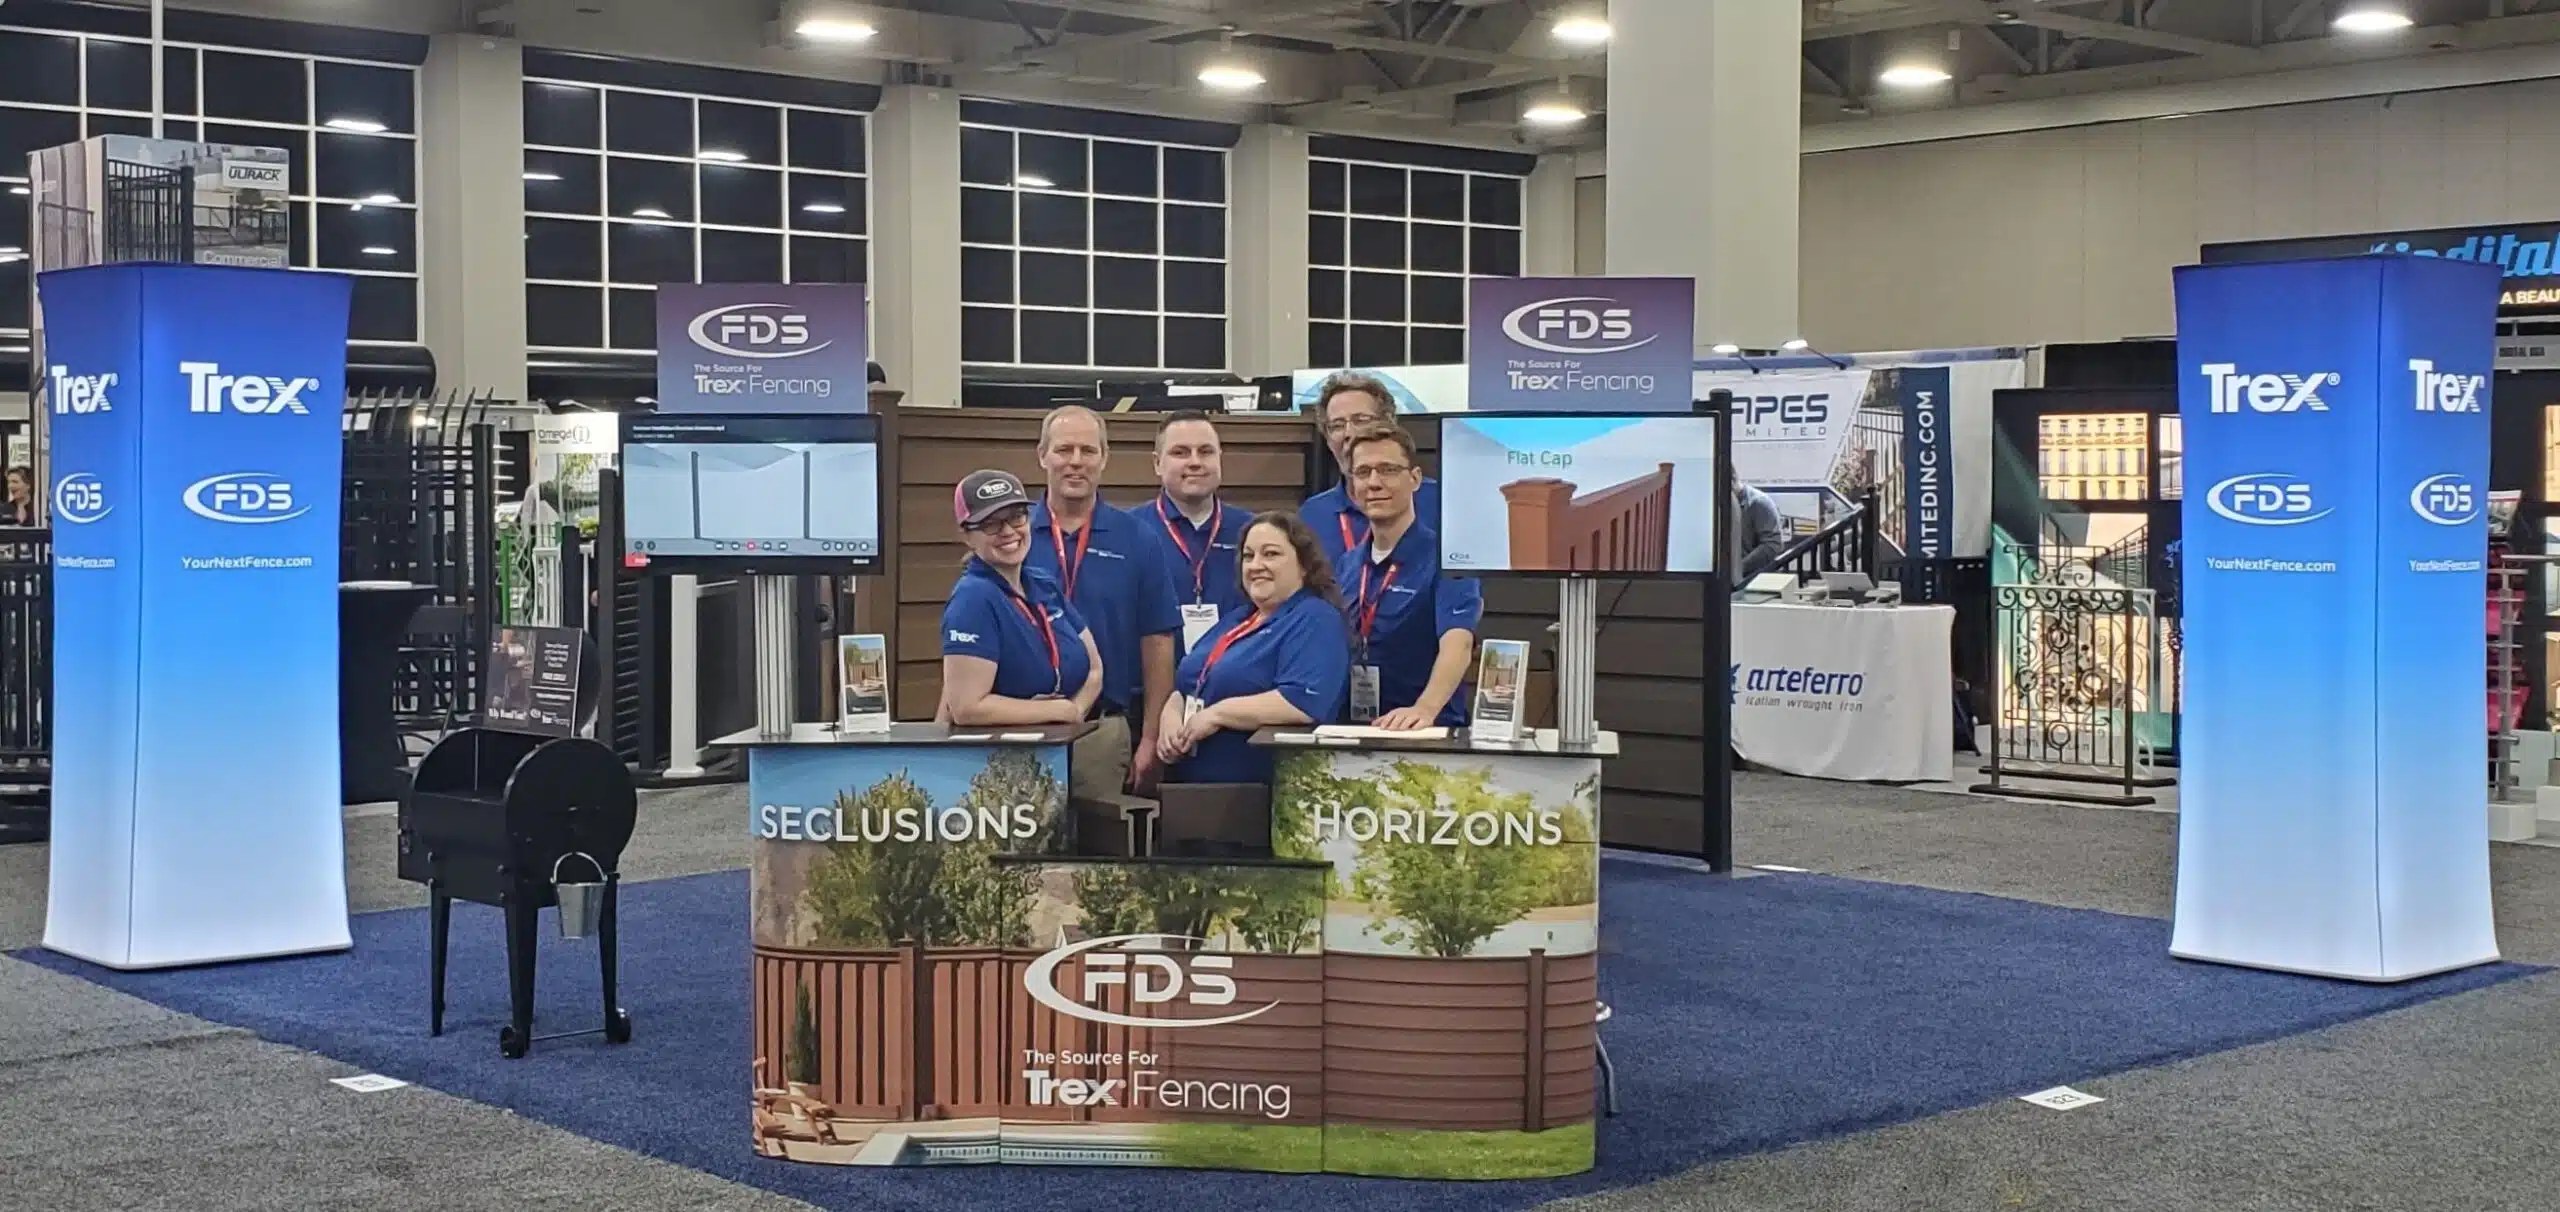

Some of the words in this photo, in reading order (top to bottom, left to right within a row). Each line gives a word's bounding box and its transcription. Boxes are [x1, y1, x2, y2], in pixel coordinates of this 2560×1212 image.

[2499, 292, 2512, 305] A
[720, 314, 809, 345] FDS
[1538, 308, 1632, 340] FDS
[694, 363, 710, 373] The
[713, 364, 744, 373] Source
[747, 363, 763, 373] For
[1507, 360, 1525, 369] The
[1528, 360, 1561, 369] Source
[1564, 360, 1581, 369] For
[749, 374, 831, 397] Fencing
[1566, 370, 1655, 394] Fencing
[1507, 451, 1535, 465] Flat
[1540, 451, 1573, 469] Cap
[66, 482, 103, 511] FDS
[214, 483, 293, 511] FDS
[2234, 484, 2312, 512] FDS
[2429, 484, 2472, 512] FDS
[181, 556, 313, 569] YourNextFence.com
[2206, 557, 2336, 572] YourNextFence.com
[1746, 666, 1863, 696] arteferro
[1787, 699, 1832, 712] wrought
[760, 803, 1038, 843] SECLUSIONS
[1313, 803, 1563, 847] HORIZONS
[1084, 953, 1237, 1005] FDS
[1023, 1050, 1055, 1065] The
[1060, 1050, 1123, 1065] Source
[1128, 1051, 1159, 1066] For
[1133, 1071, 1291, 1119] Fencing
